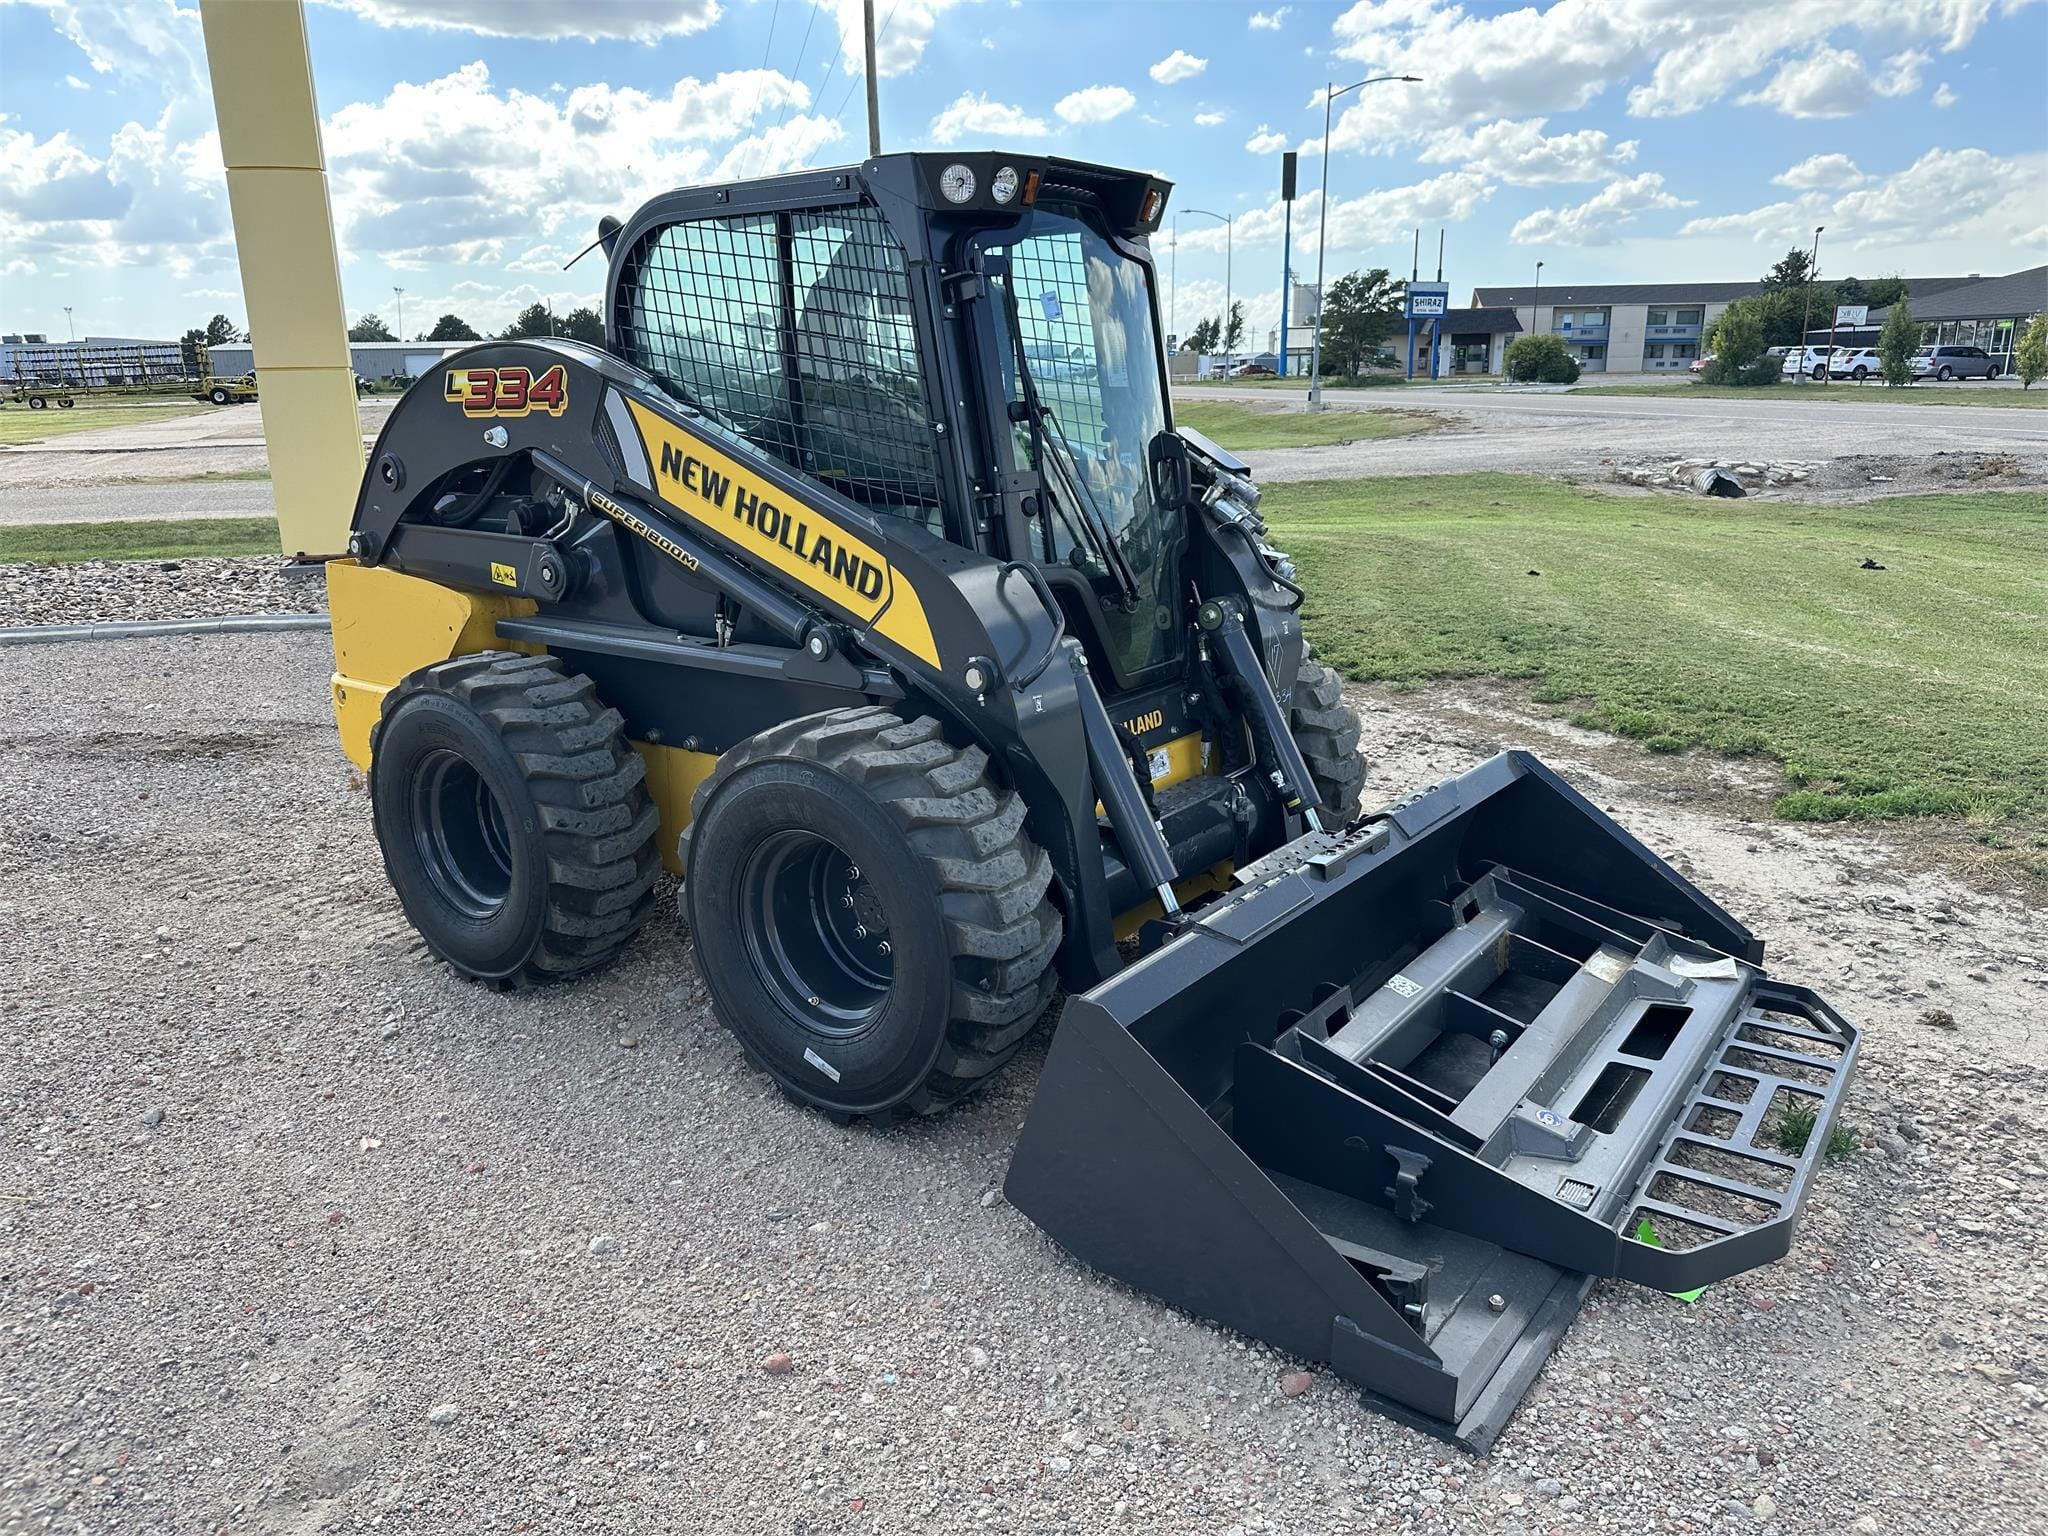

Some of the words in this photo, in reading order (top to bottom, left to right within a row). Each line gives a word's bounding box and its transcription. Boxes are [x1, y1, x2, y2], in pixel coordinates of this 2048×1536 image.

[1415, 298, 1442, 308] SHIRAZ
[445, 365, 568, 417] L334
[592, 491, 648, 538] SUPER
[646, 528, 699, 571] BOOM
[660, 441, 731, 511] NEW
[733, 486, 884, 602] HOLLAND
